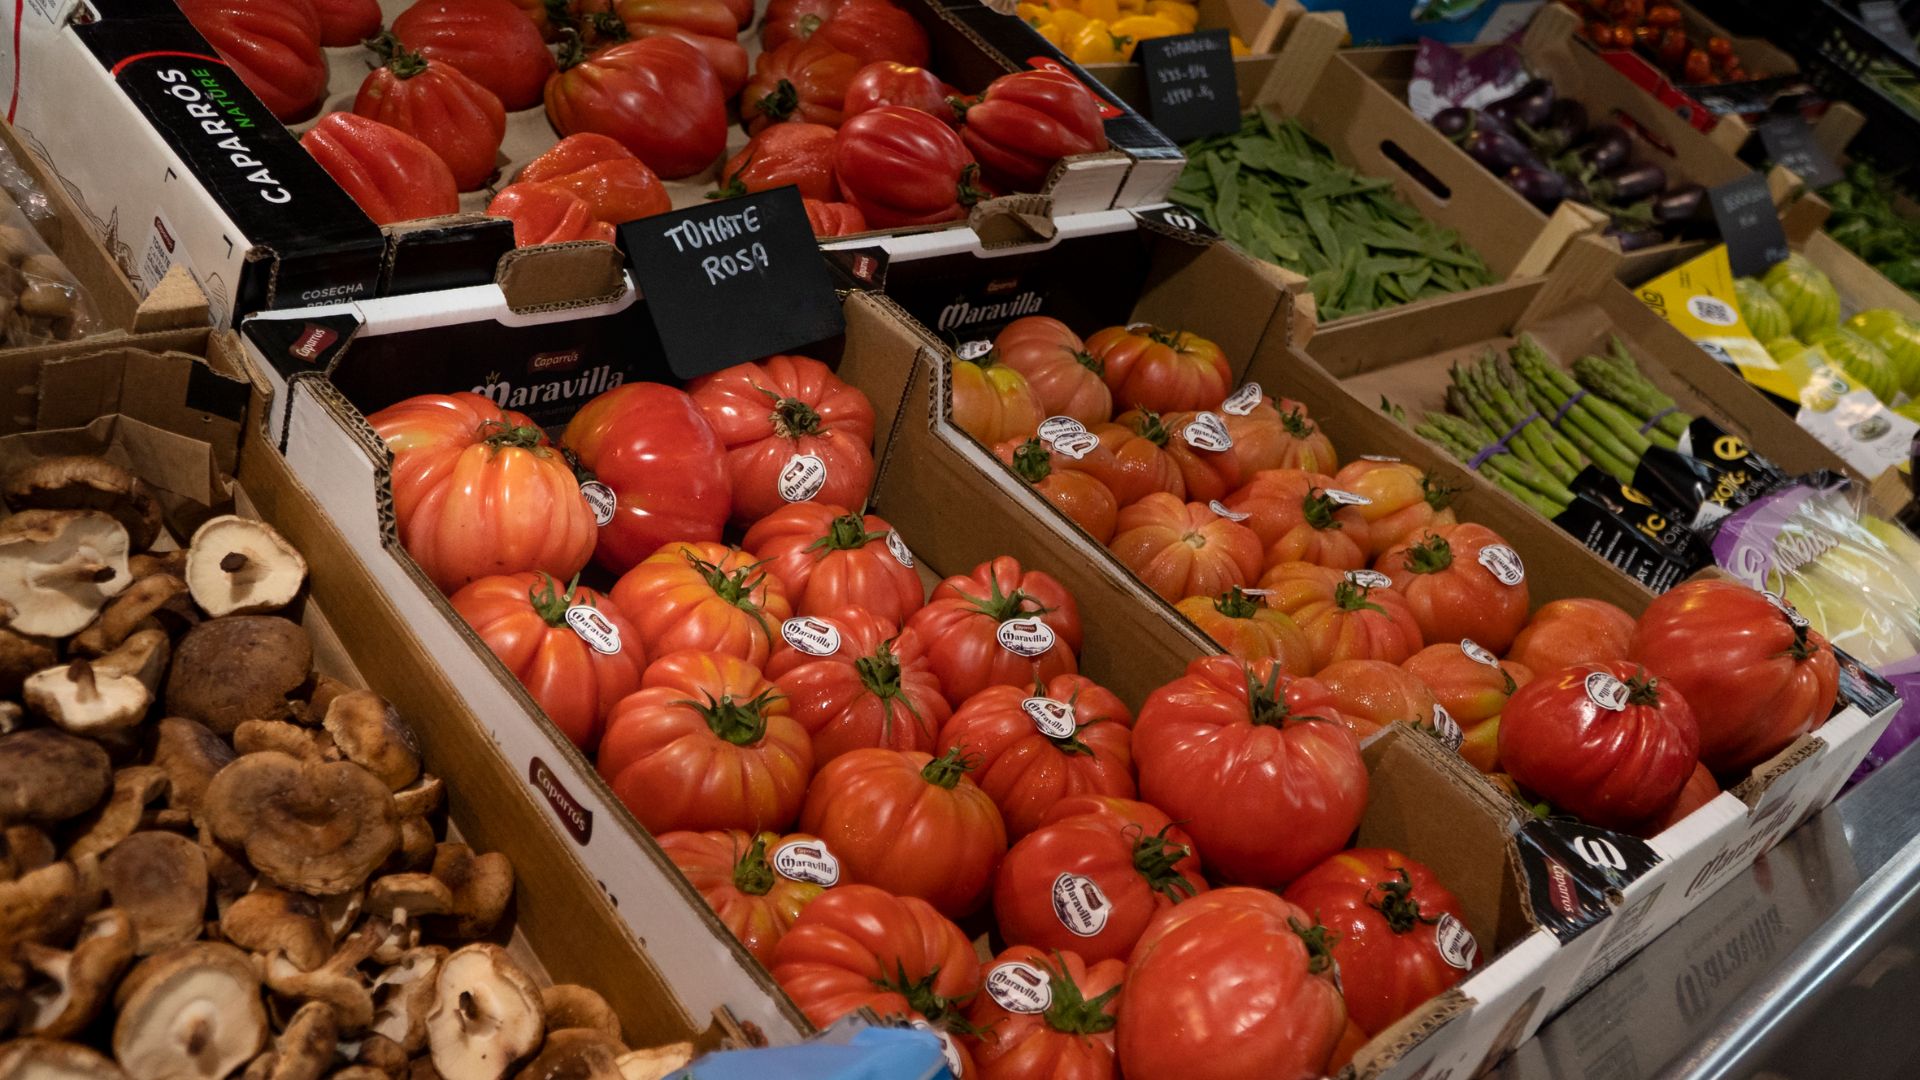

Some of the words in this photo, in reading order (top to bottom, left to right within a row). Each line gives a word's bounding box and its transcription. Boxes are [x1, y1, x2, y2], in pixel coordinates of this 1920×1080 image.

[192, 69, 254, 128] NATURE
[157, 69, 291, 203] CAPARRÓS
[664, 205, 761, 253] TOMATE
[701, 242, 769, 286] ROSA
[301, 283, 364, 300] COSECHA
[572, 611, 612, 647] Maravilla
[788, 623, 831, 648] Maravilla
[1003, 630, 1048, 643] Maravilla
[1028, 702, 1065, 732] Maravilla
[781, 856, 833, 874] Maravilla
[1062, 877, 1092, 928] Maravilla
[992, 971, 1041, 1003] Maravilla
